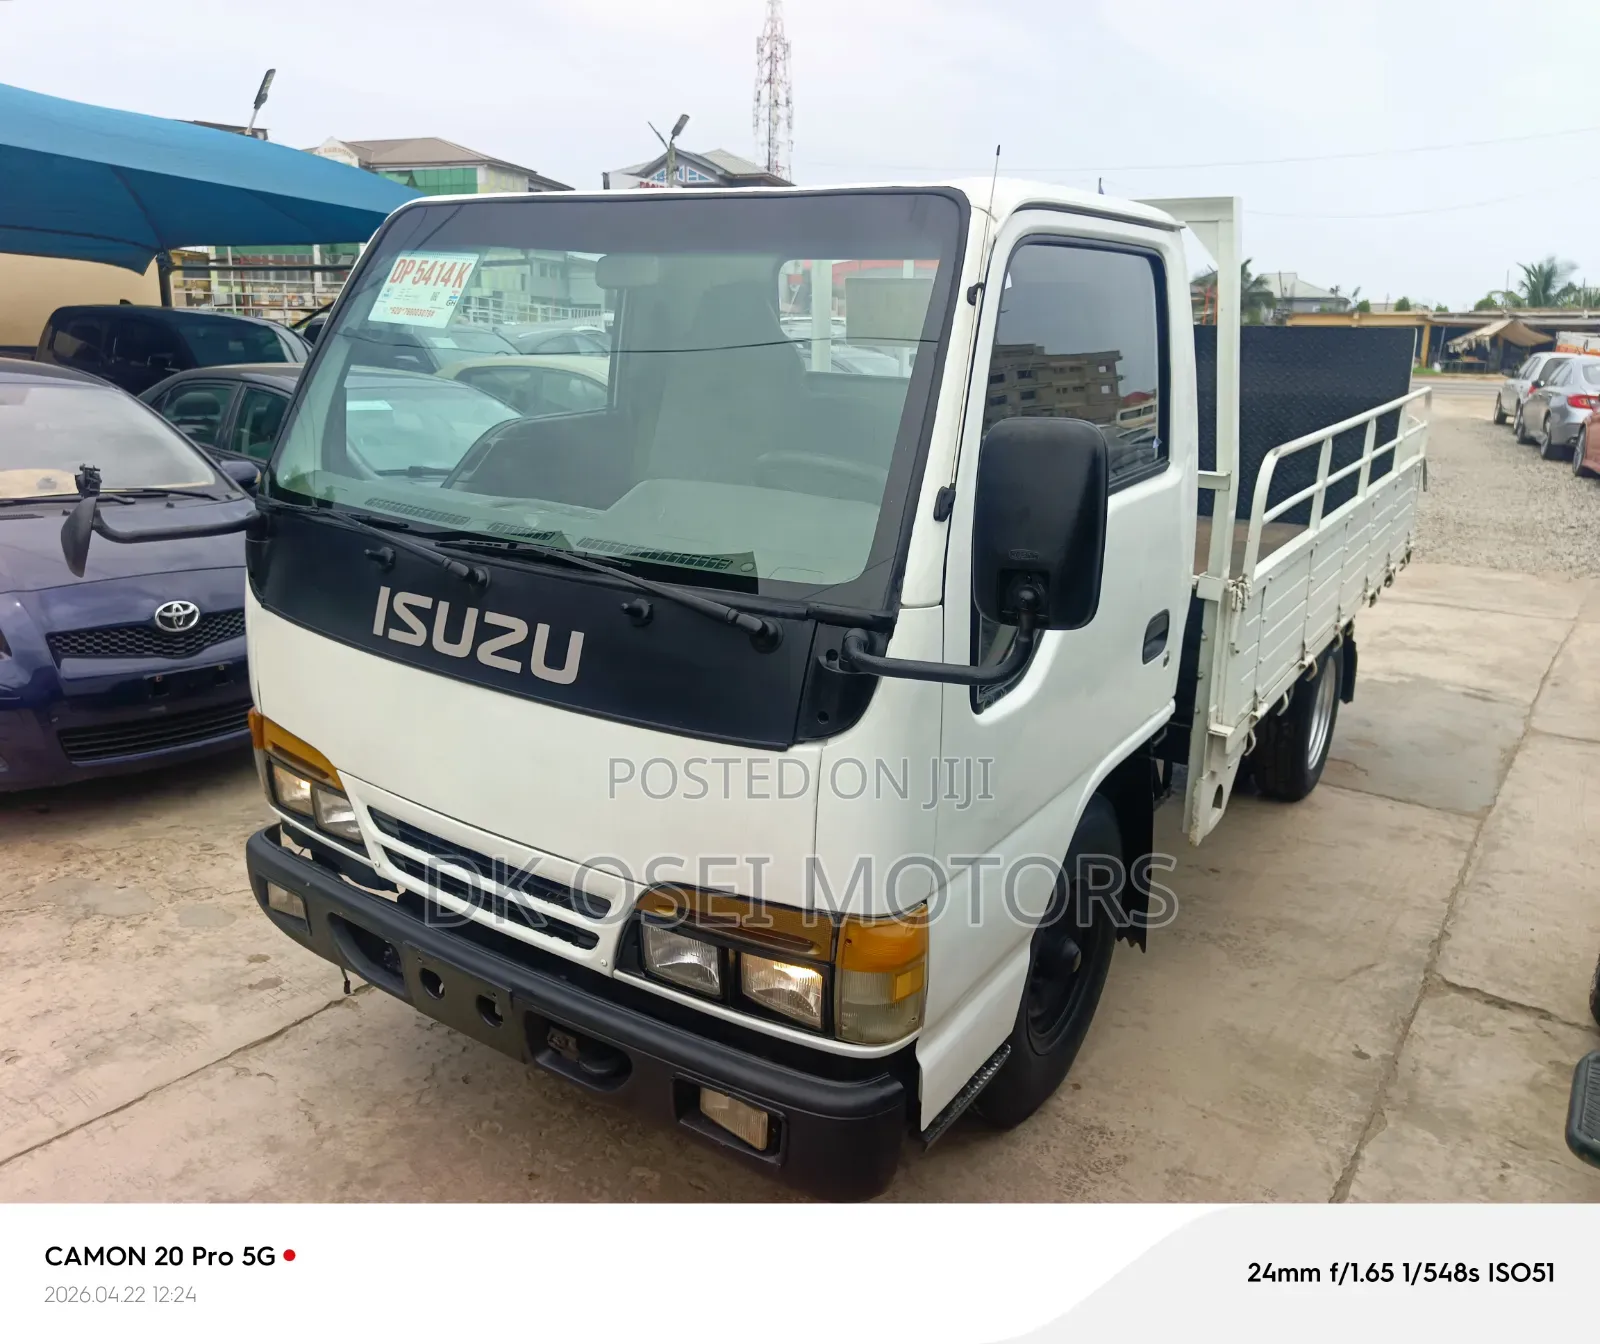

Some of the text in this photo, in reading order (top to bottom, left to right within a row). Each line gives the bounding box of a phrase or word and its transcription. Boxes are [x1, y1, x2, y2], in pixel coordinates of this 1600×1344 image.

[389, 259, 472, 289] DP 5414 K
[372, 585, 585, 685] ISUZU
